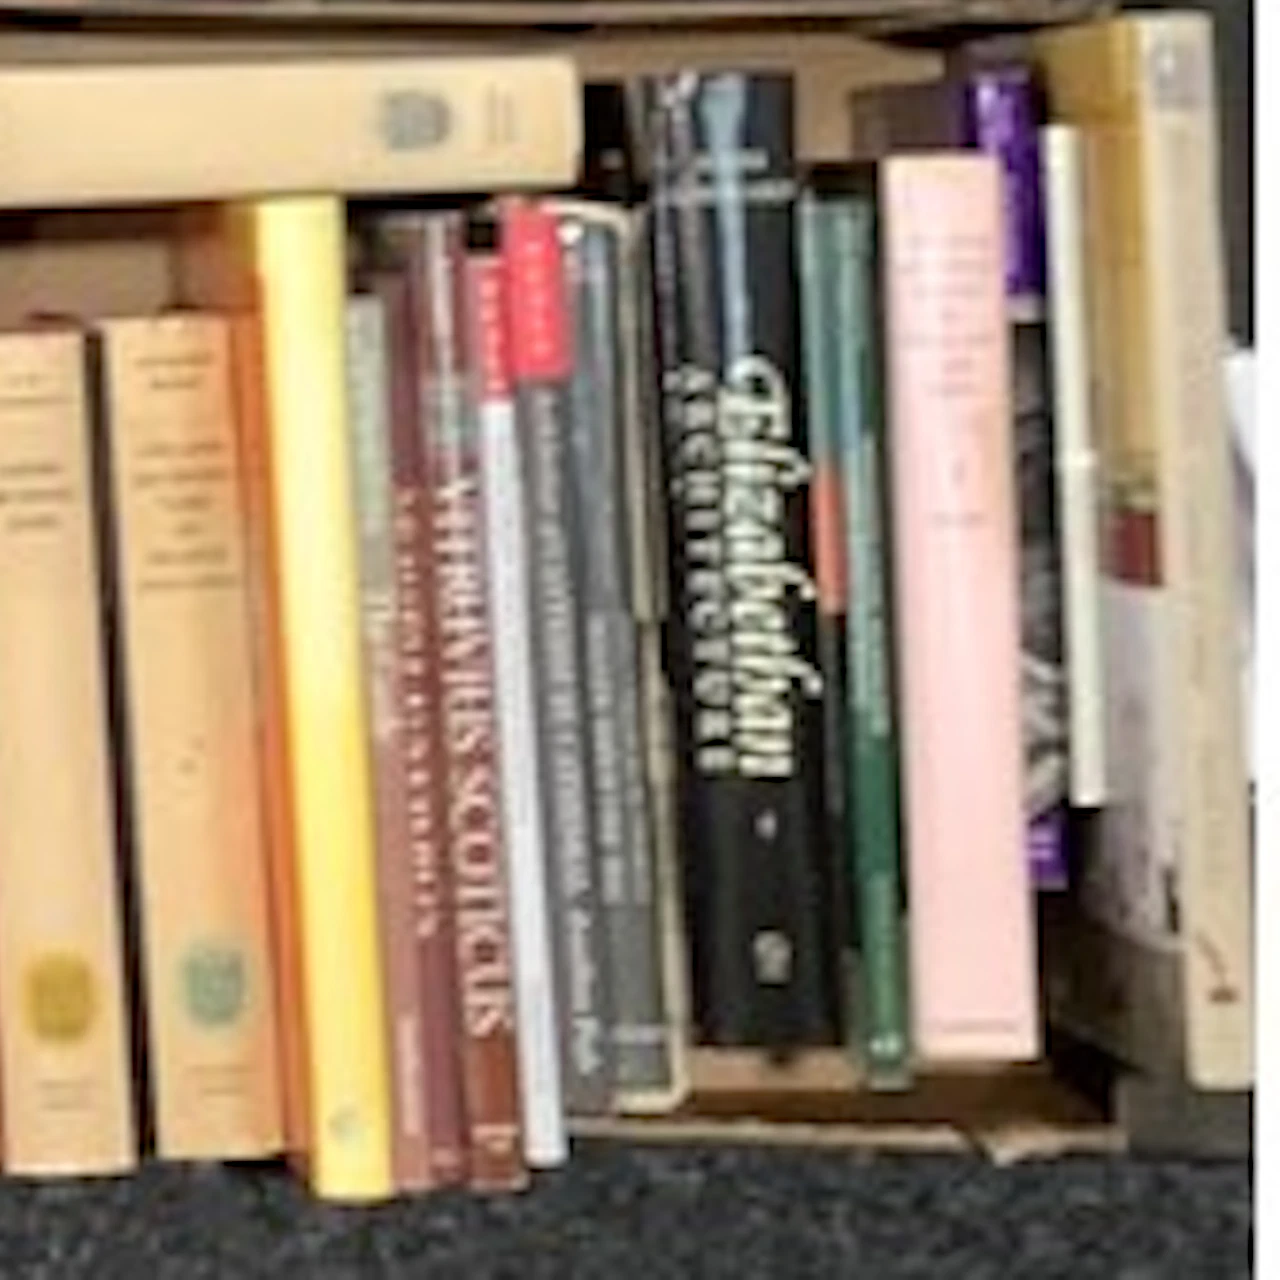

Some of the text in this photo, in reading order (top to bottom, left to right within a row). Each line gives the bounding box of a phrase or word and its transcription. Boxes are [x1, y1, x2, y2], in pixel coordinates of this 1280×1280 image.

[432, 475, 512, 1038] VITRUVIUS SCOTICUS
[662, 367, 734, 773] ARCHITECTURE
[718, 354, 824, 779] Elizabethan
